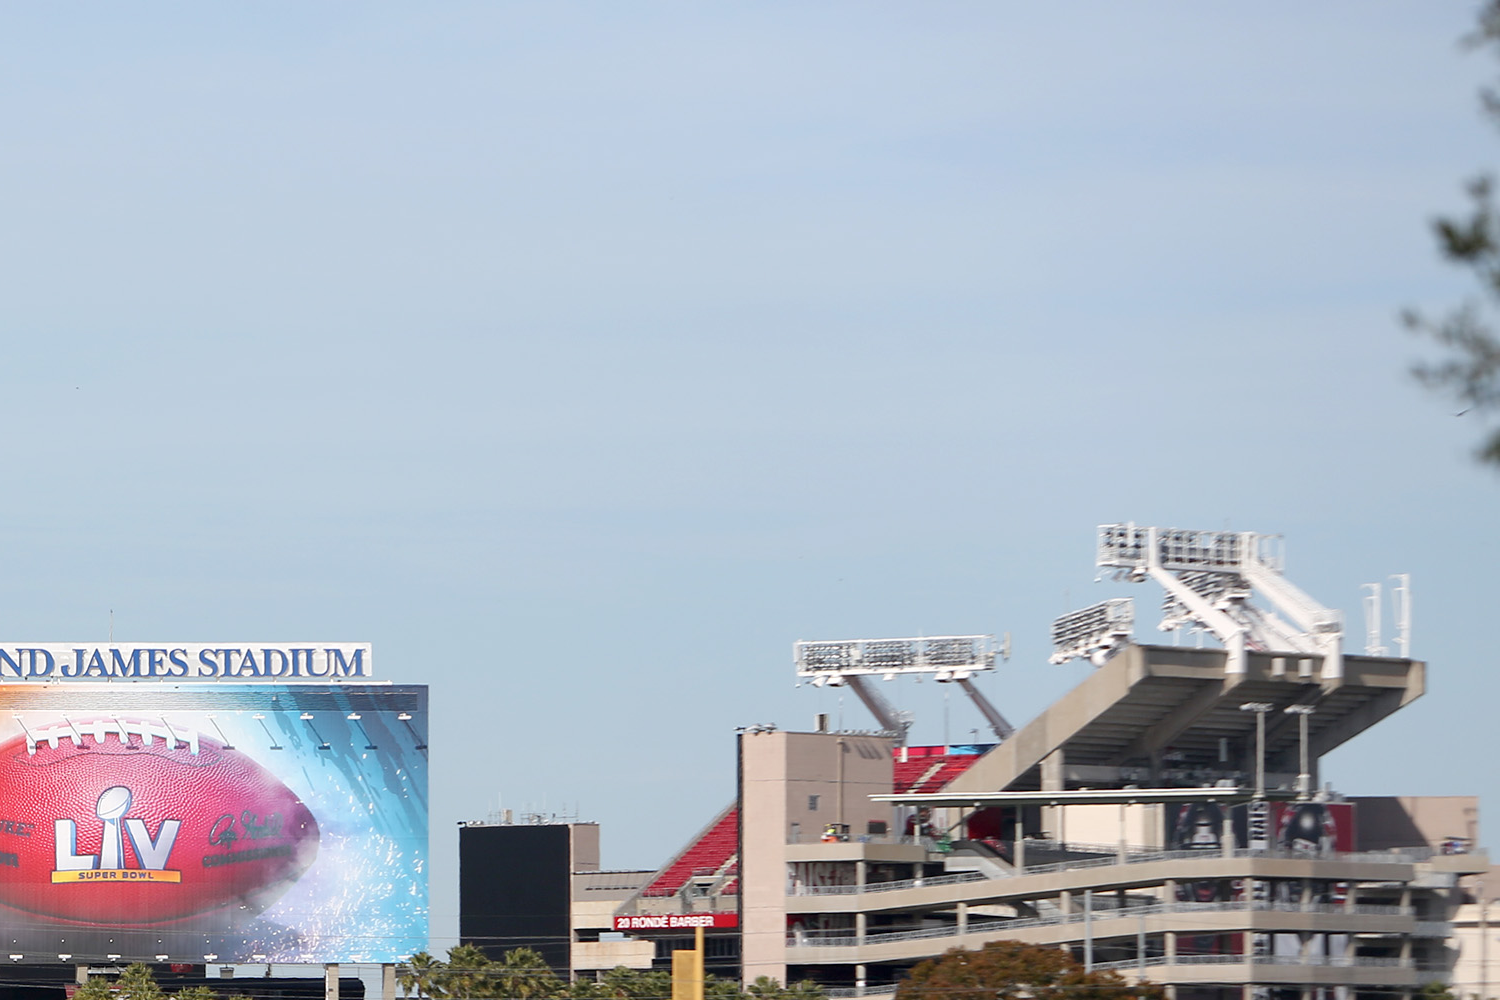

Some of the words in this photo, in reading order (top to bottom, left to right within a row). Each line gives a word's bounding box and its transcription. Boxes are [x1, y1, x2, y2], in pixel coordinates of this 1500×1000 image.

[60, 647, 189, 678] JAMES
[198, 647, 366, 677] STADIUM
[54, 785, 182, 870] LIV
[78, 871, 117, 880] SUPER
[122, 871, 155, 880] BOWL
[617, 917, 630, 929] 20
[631, 915, 669, 928] RONDÉ
[670, 916, 714, 927] BARBER
